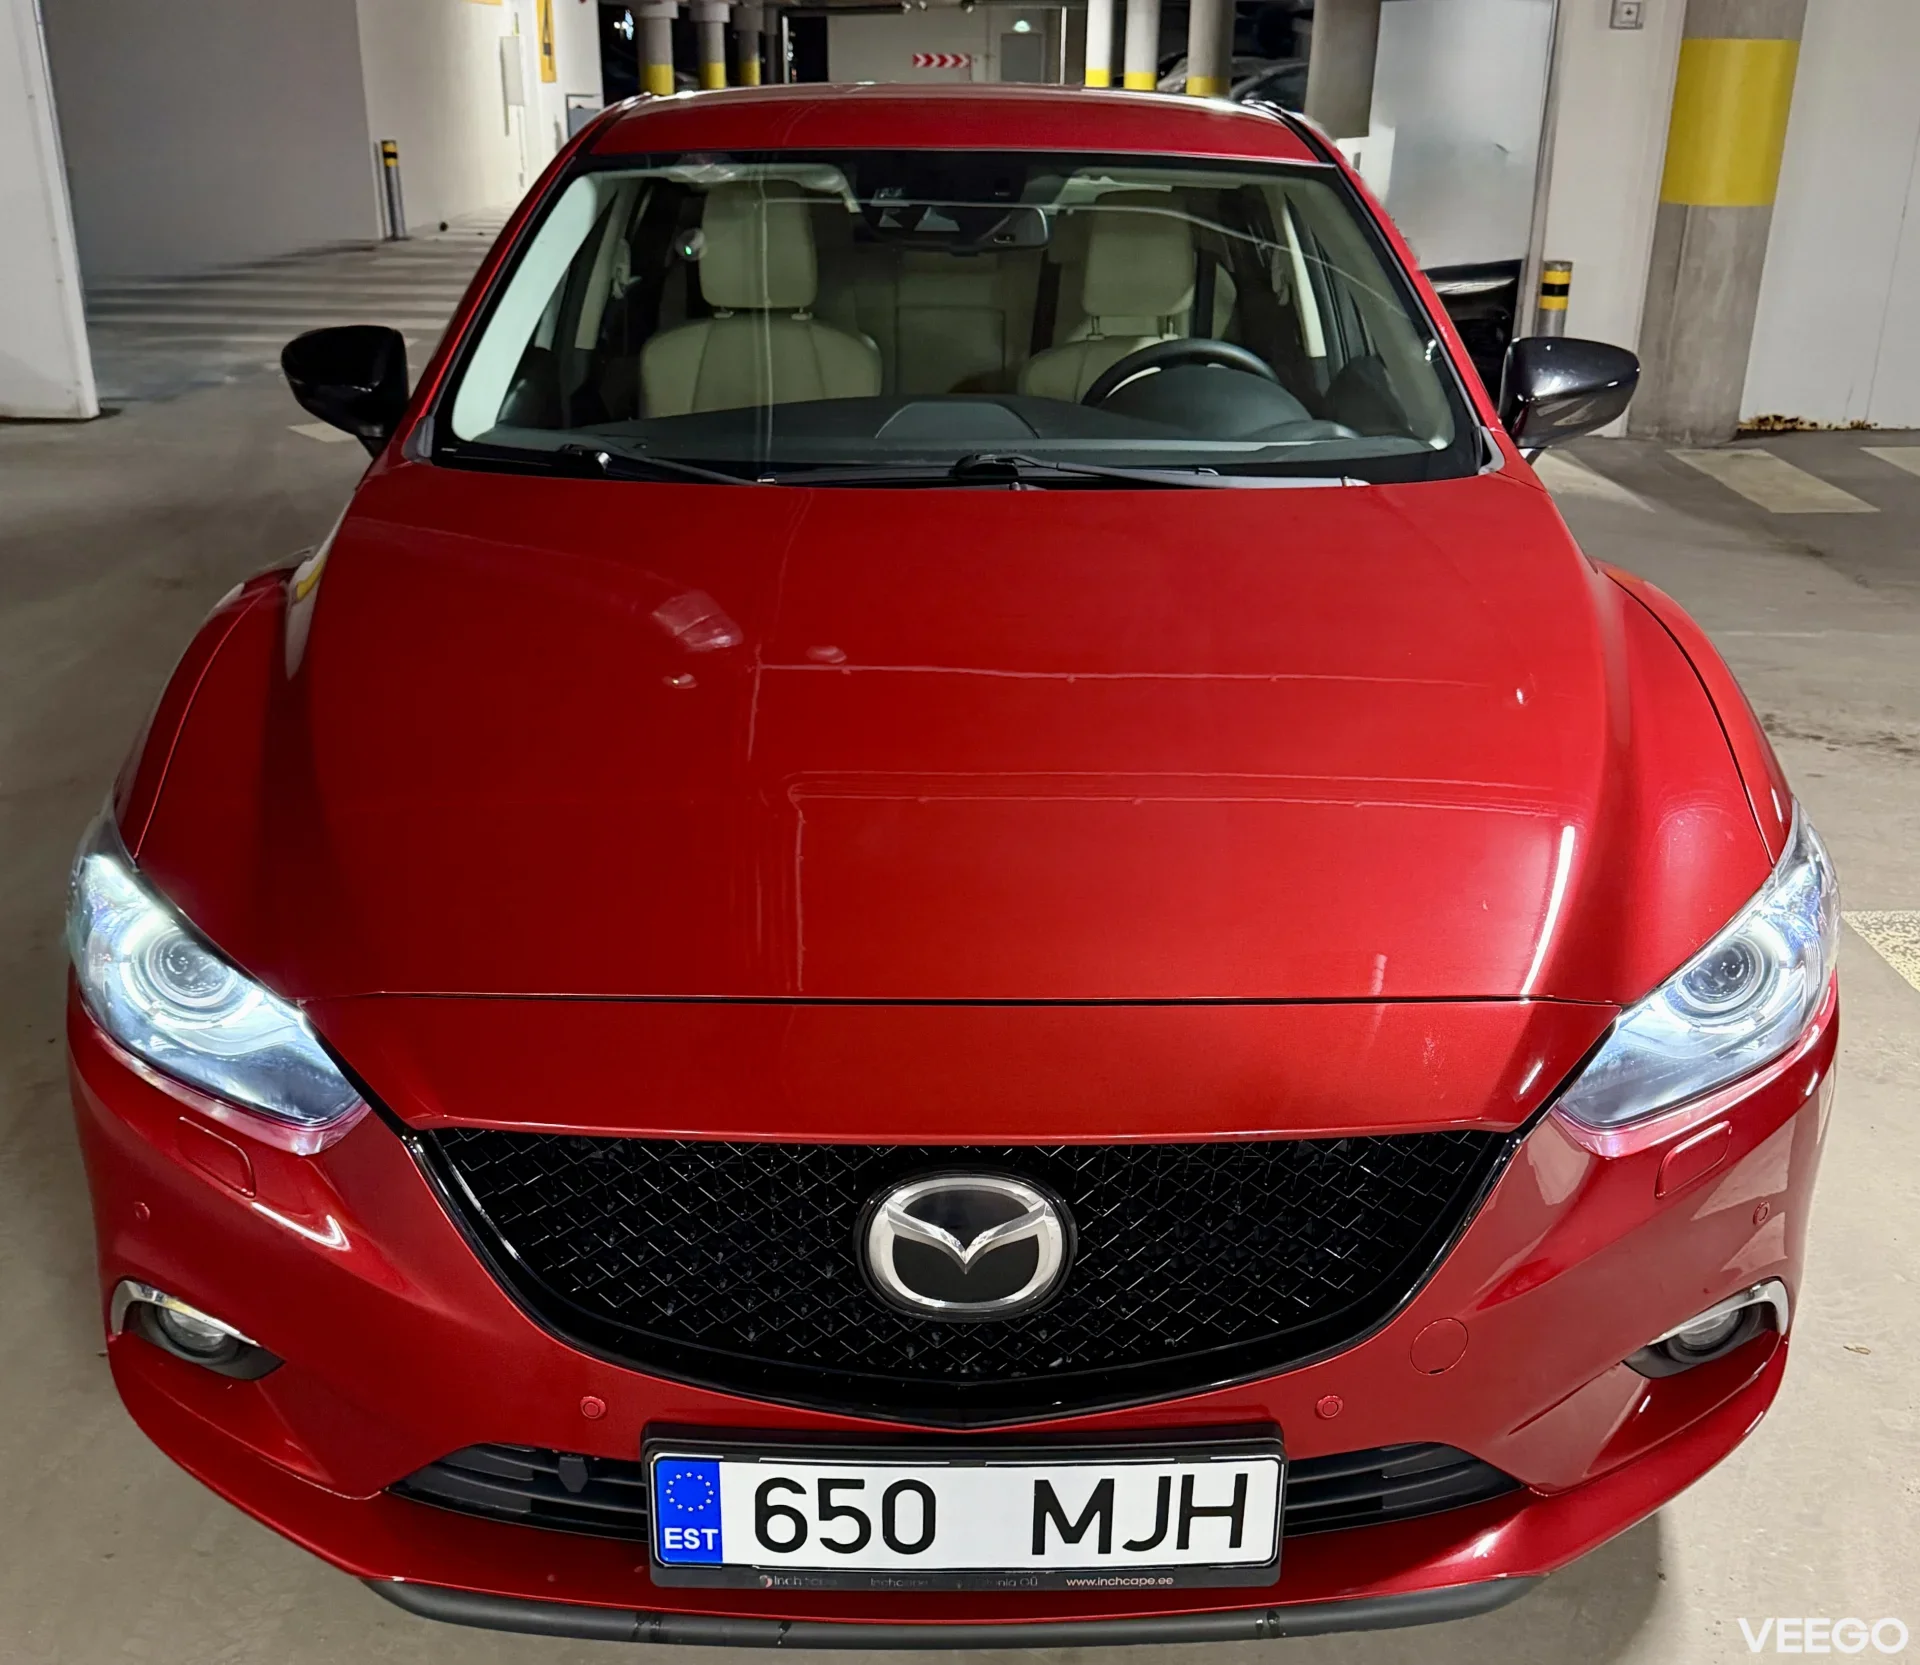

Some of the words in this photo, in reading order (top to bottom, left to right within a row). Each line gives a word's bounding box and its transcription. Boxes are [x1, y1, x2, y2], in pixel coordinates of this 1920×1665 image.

[755, 1477, 936, 1555] 650
[1031, 1473, 1248, 1555] MJH
[664, 1528, 719, 1550] EST
[1066, 1576, 1174, 1587] www.inchcape.ee
